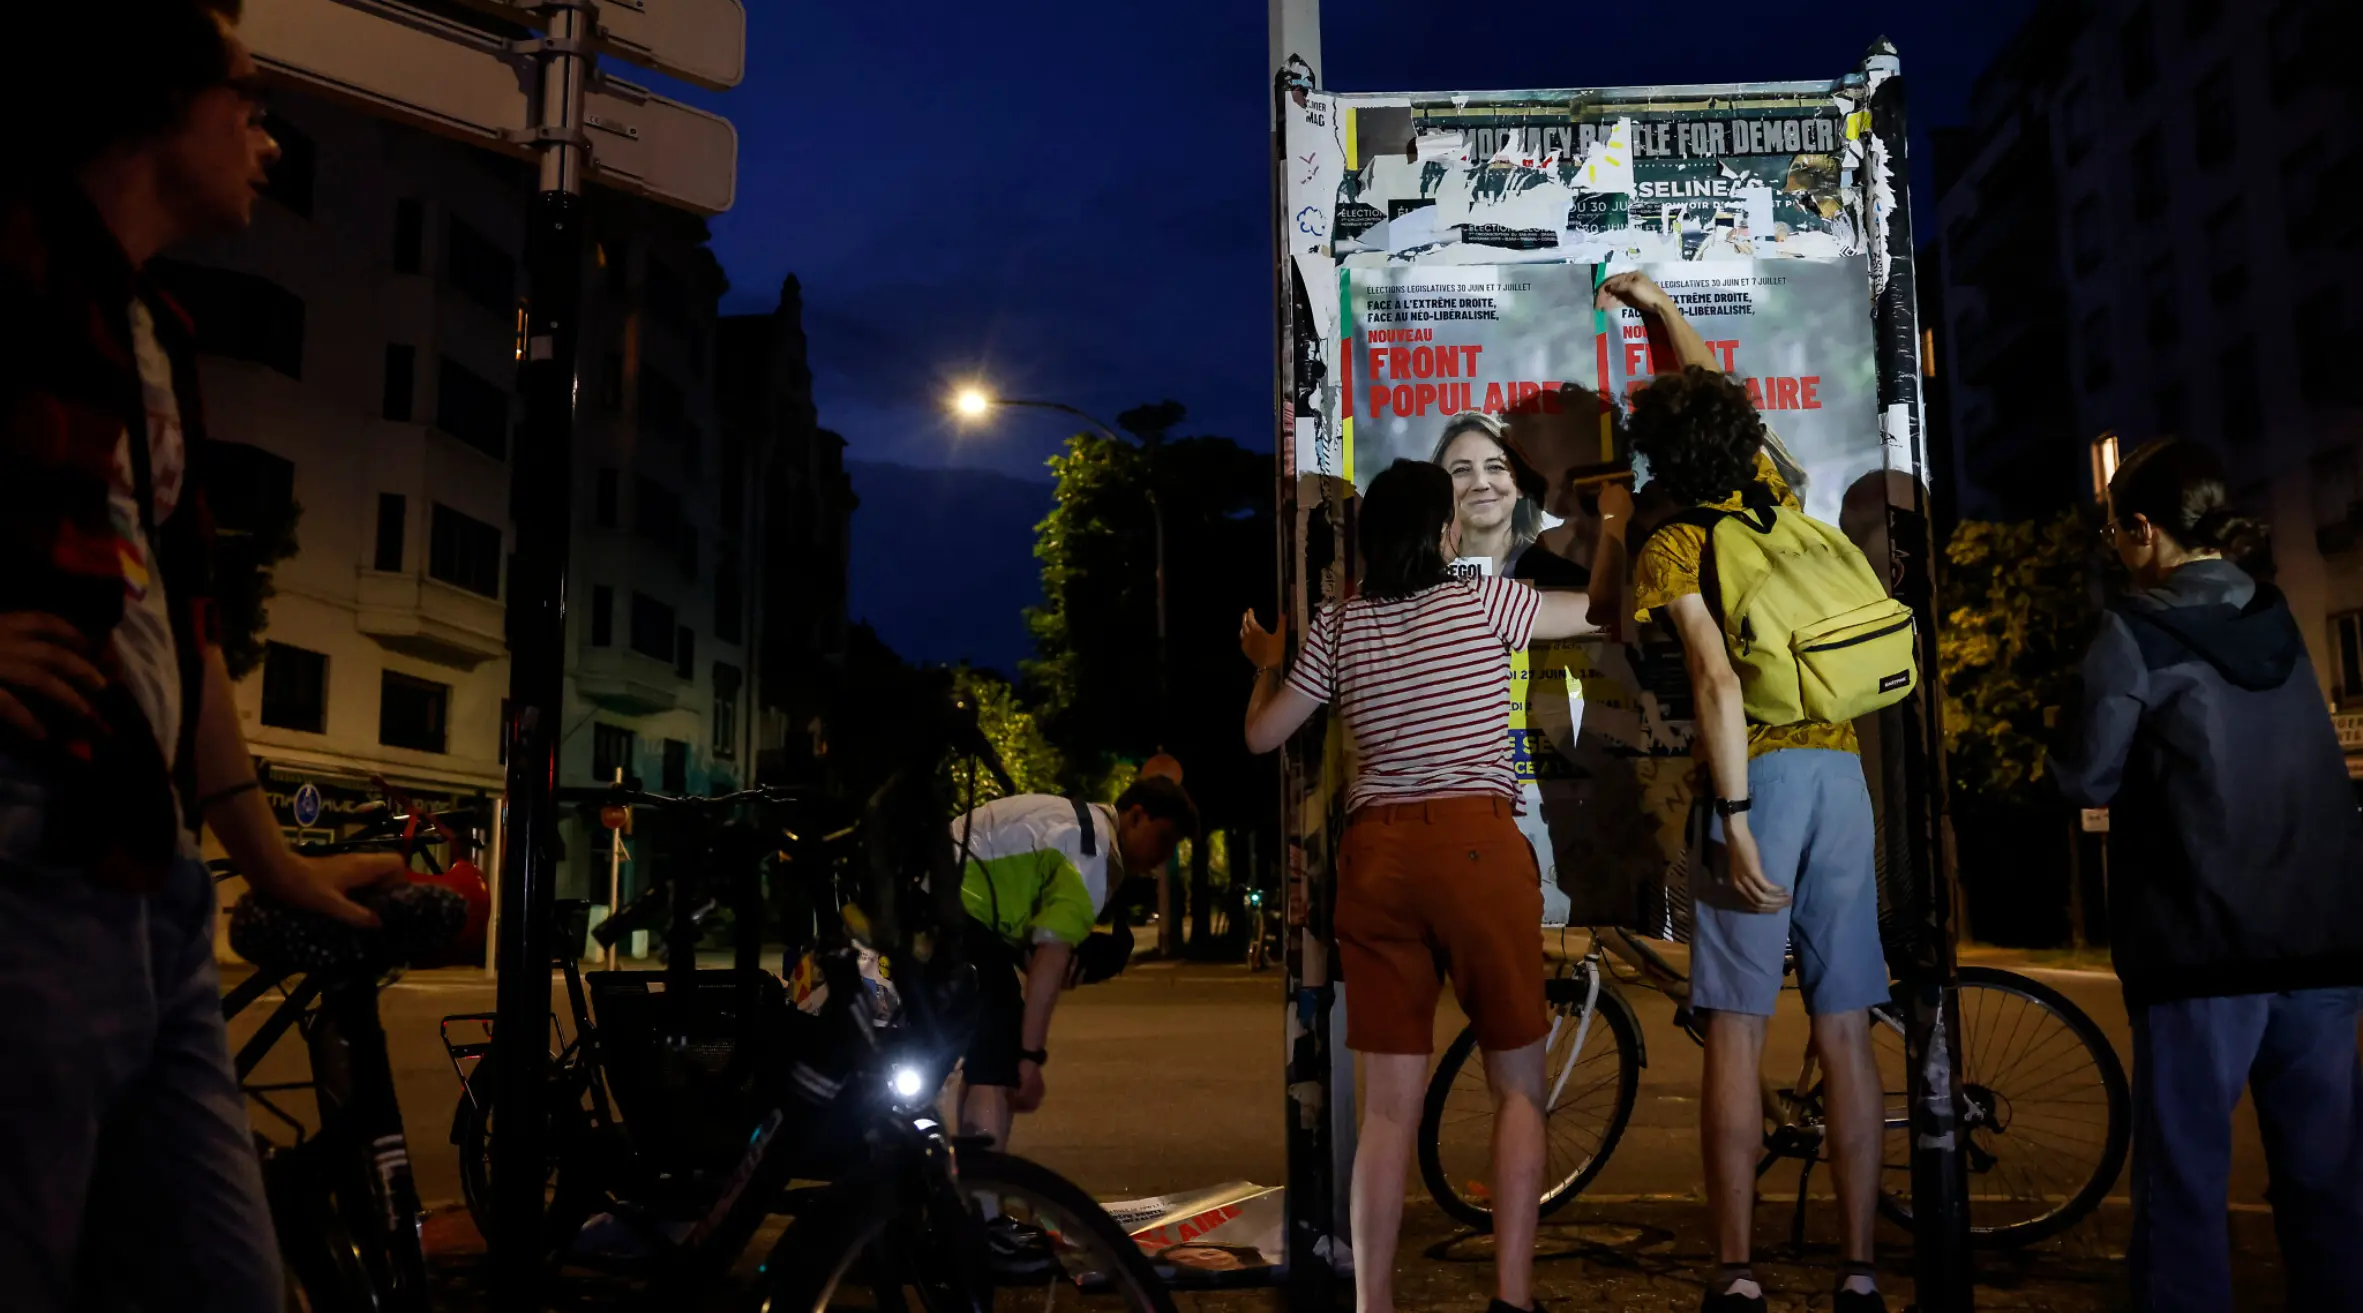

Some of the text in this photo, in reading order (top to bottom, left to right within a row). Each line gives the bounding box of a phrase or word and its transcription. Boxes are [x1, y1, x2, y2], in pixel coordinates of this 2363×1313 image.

[1677, 122, 1726, 156] FOR
[1732, 119, 1837, 154] DEMOCR
[1590, 202, 1606, 212] 30
[1457, 284, 1466, 292] 30
[1468, 284, 1484, 292] JUIN
[1503, 283, 1532, 291] JUILLET
[1712, 279, 1721, 287] 30
[1723, 278, 1740, 287] JUIN
[1741, 278, 1749, 286] ET
[1752, 277, 1757, 285] 7
[1758, 277, 1787, 286] JUILLET
[1367, 300, 1393, 310] FACE
[1404, 296, 1456, 309] L'EXTRÊME
[1459, 297, 1496, 309] DROITE,
[1714, 293, 1752, 304] DROITE,
[1368, 313, 1393, 323] FACE
[1395, 312, 1408, 322] AU
[1622, 308, 1641, 319] FAC
[1367, 328, 1433, 344] NOUVEAU
[1369, 344, 1483, 380] FRONT
[1370, 381, 1565, 419] POPULAIRE
